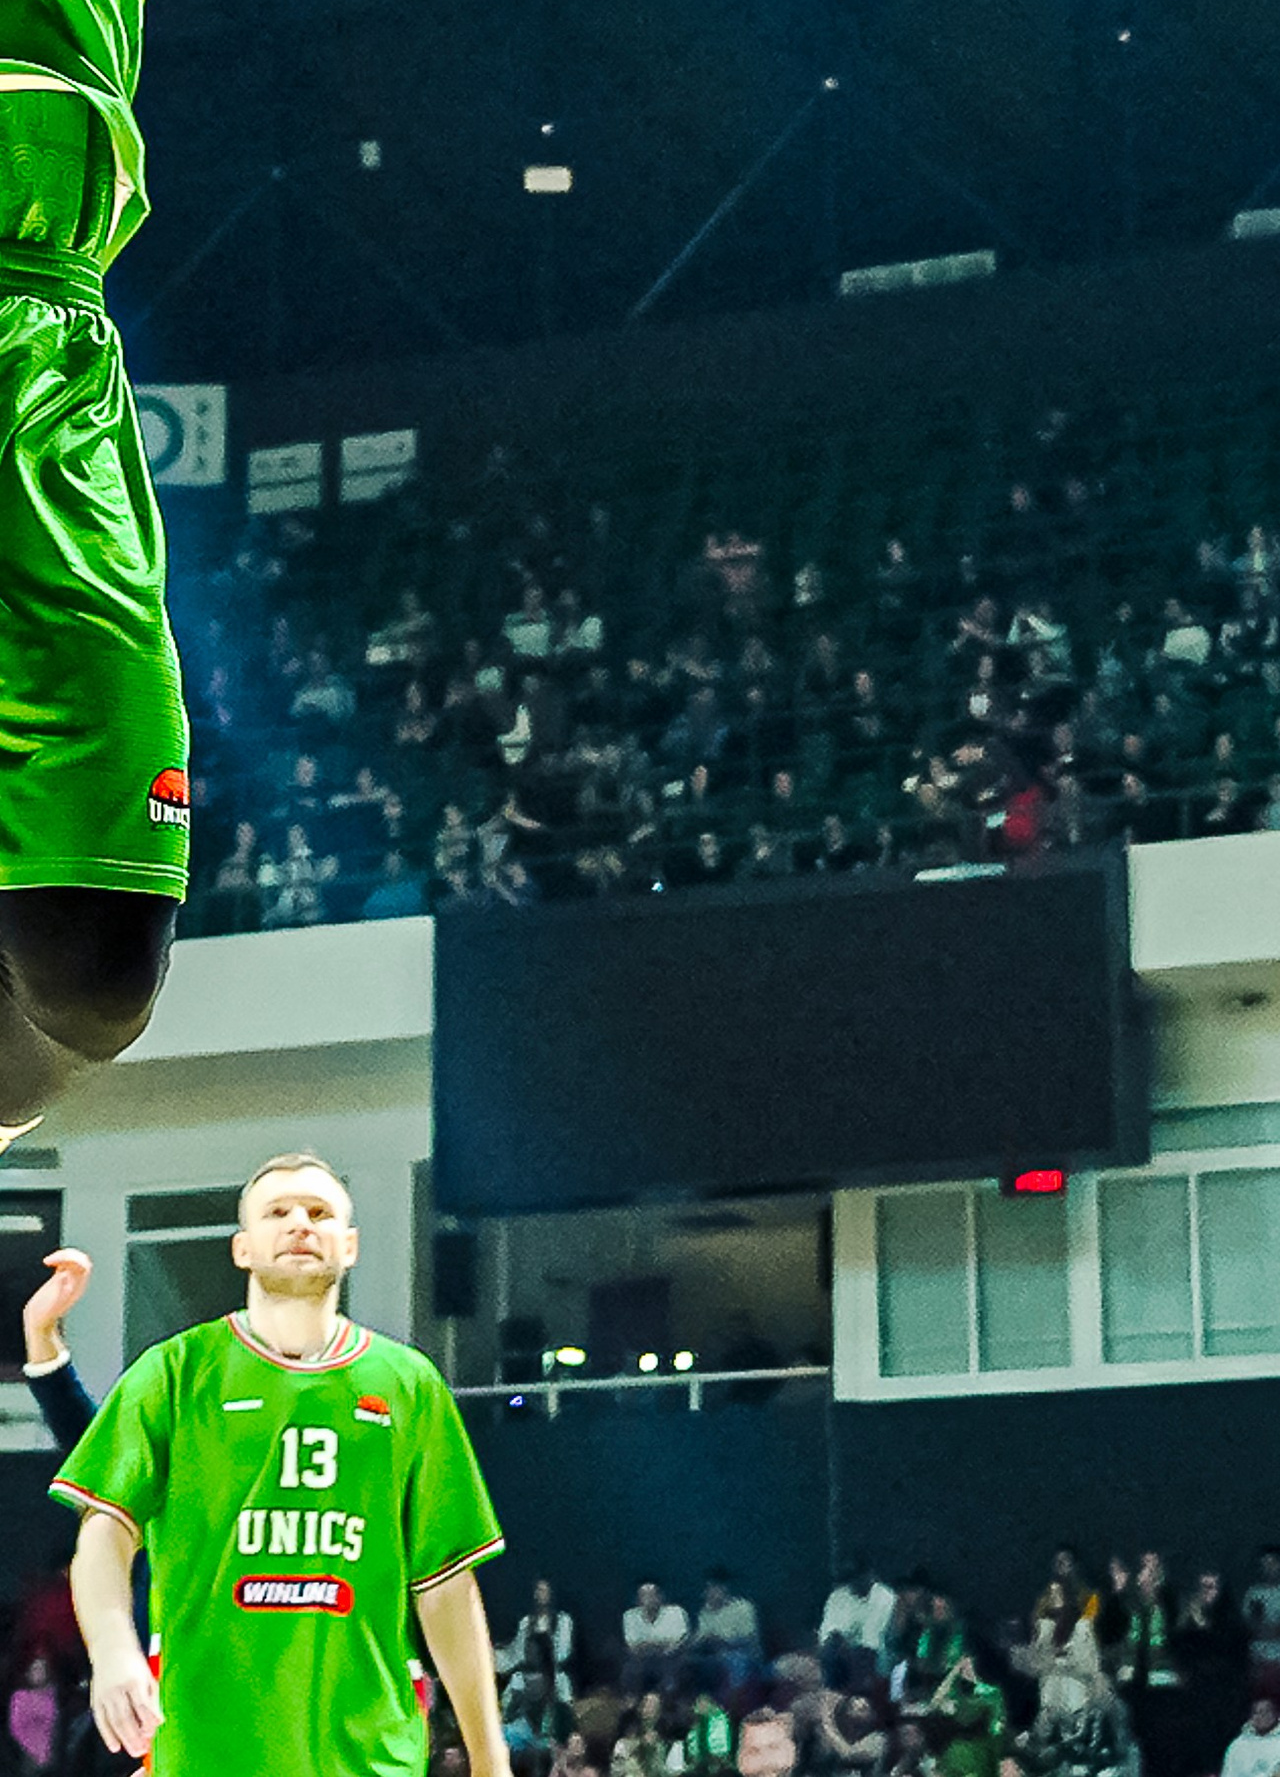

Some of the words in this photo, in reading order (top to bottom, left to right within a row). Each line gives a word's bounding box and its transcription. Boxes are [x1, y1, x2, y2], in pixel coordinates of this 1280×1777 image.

[279, 1426, 339, 1489] 13
[237, 1509, 366, 1563] UNICS
[242, 1581, 341, 1606] WINLINE
